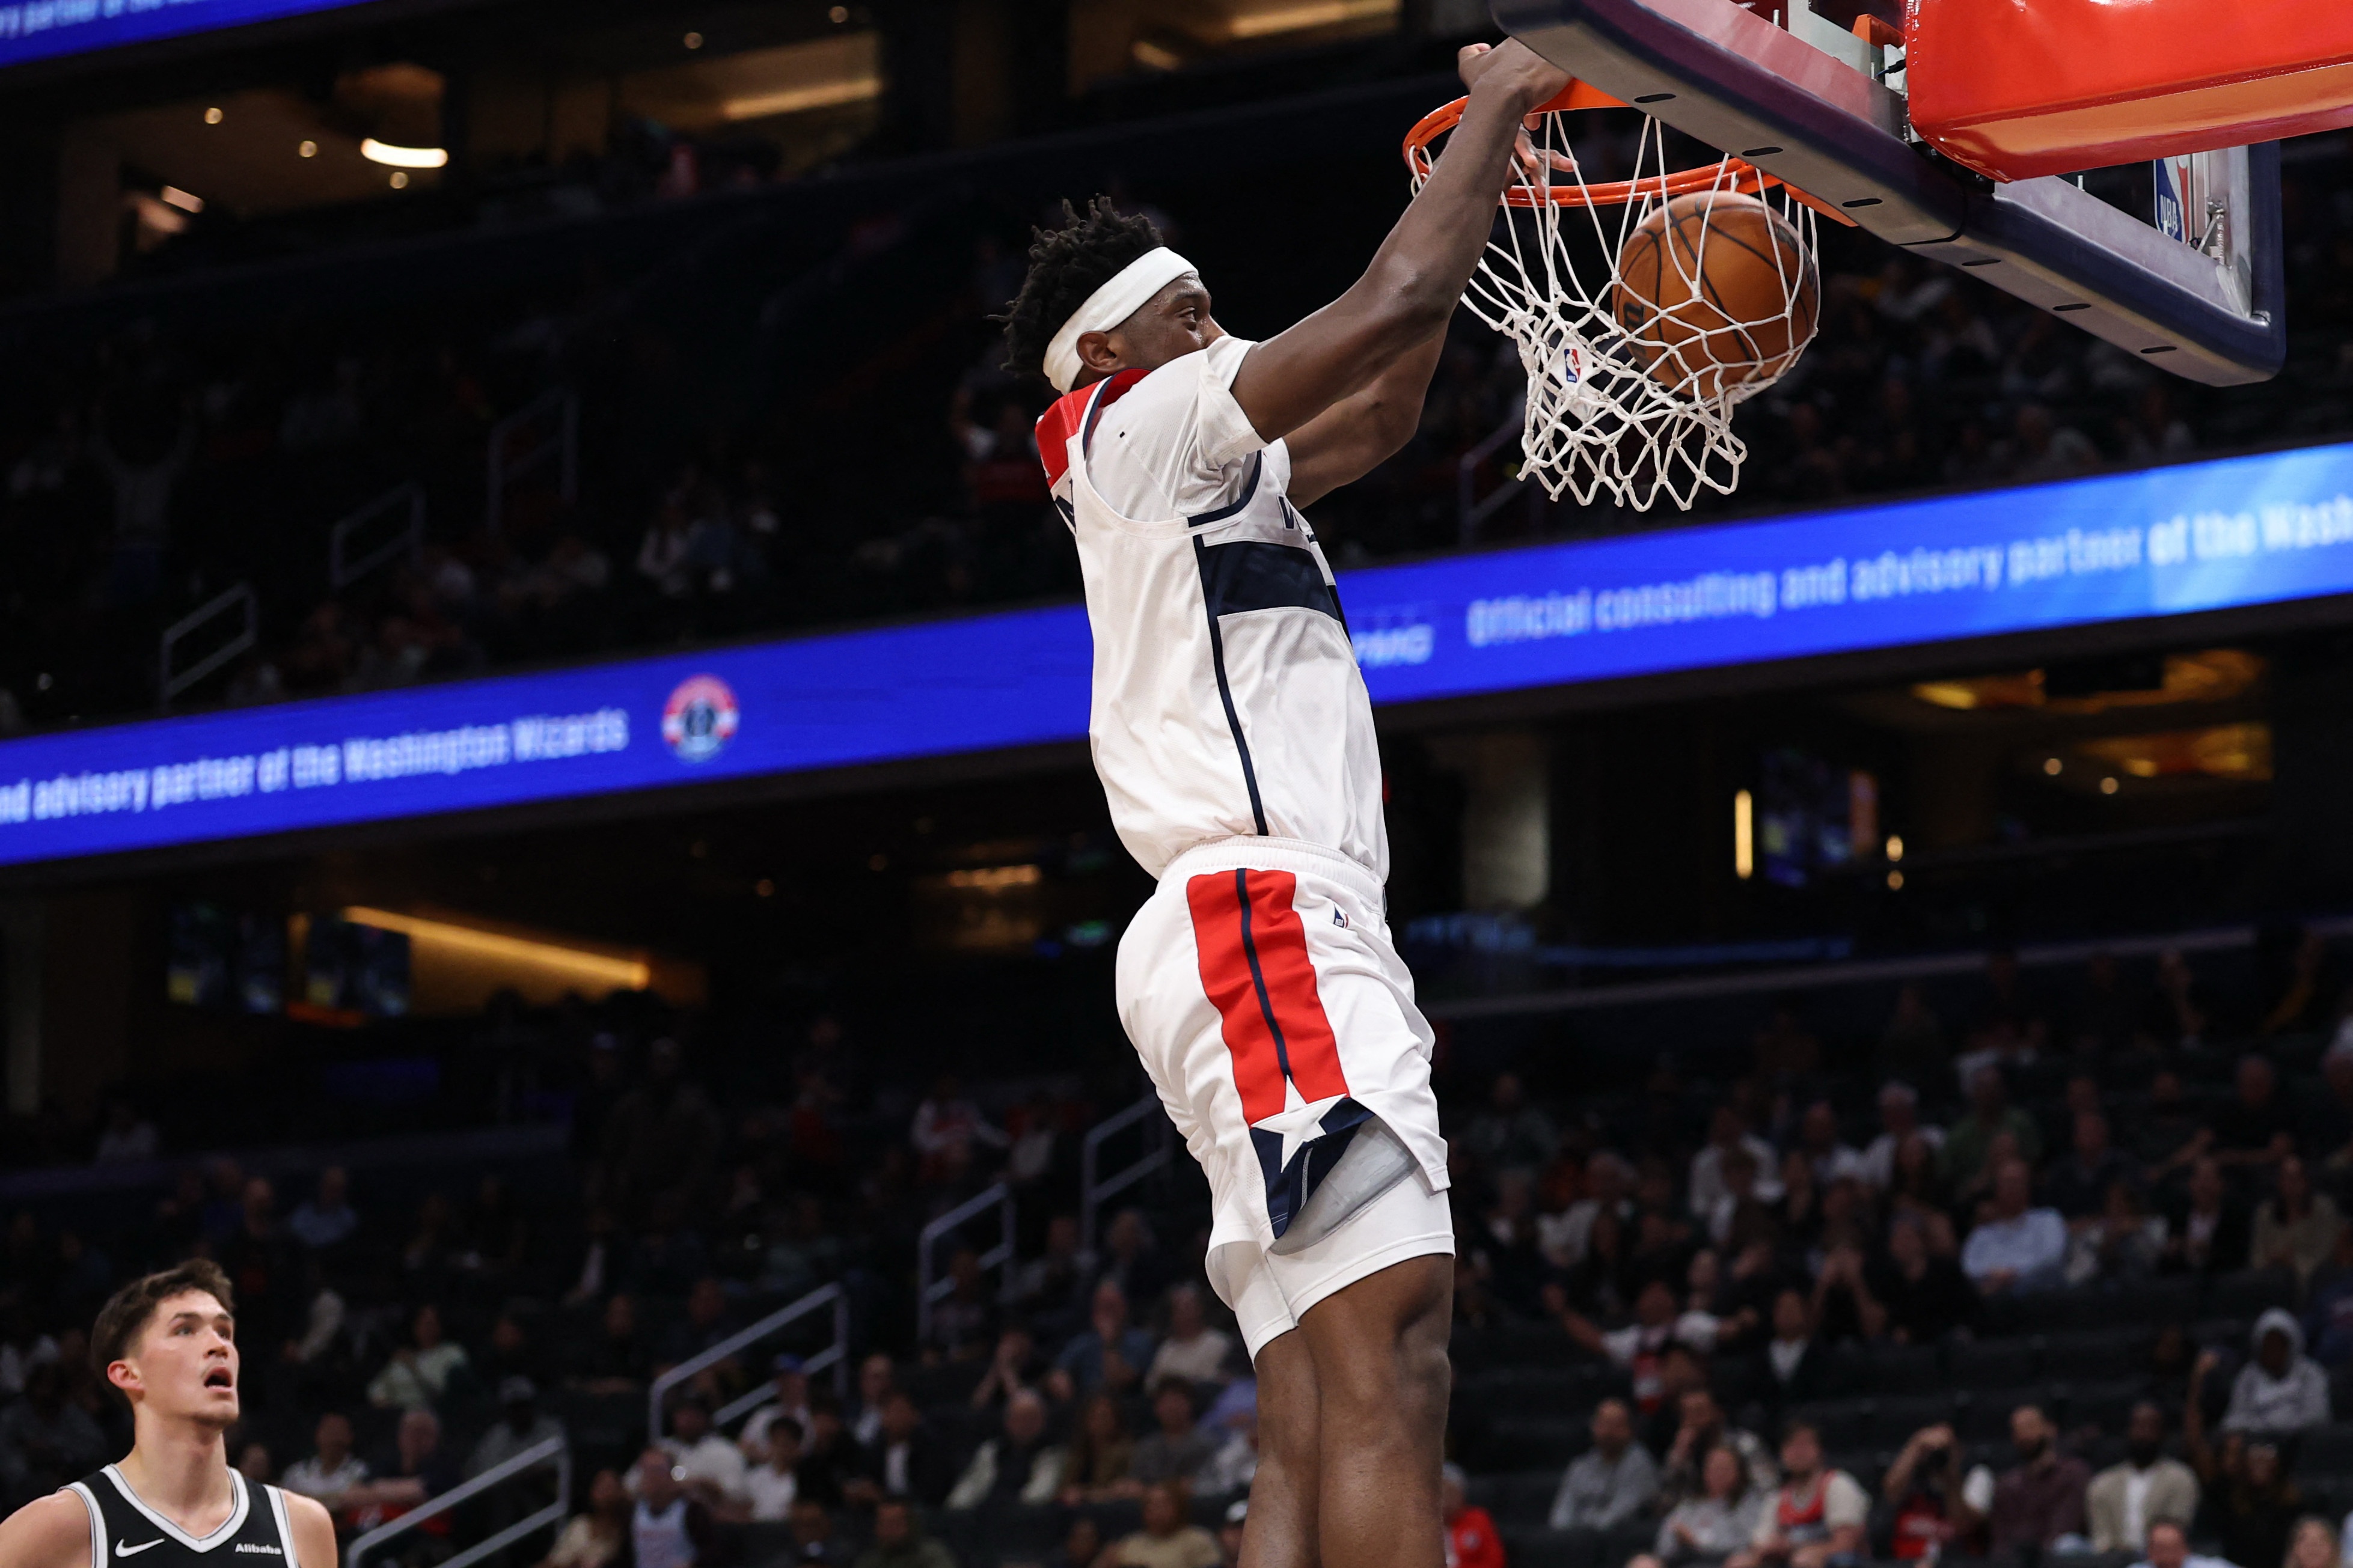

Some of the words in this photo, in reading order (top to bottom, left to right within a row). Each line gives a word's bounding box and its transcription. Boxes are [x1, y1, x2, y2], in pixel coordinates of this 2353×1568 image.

[2160, 194, 2178, 232] NBA
[1466, 588, 1593, 647] Official
[1593, 570, 1777, 632] consulting
[1780, 557, 1848, 609] and
[1850, 546, 2005, 601] advisory
[2007, 525, 2141, 585] partner
[2147, 513, 2188, 567] of
[2192, 510, 2258, 560] the
[32, 769, 151, 820] advisory
[151, 755, 257, 810] partner
[257, 748, 291, 793] of
[292, 743, 342, 789] the
[343, 724, 510, 782] Washington
[511, 709, 629, 762] Wizards
[235, 1542, 282, 1555] Alibaba
